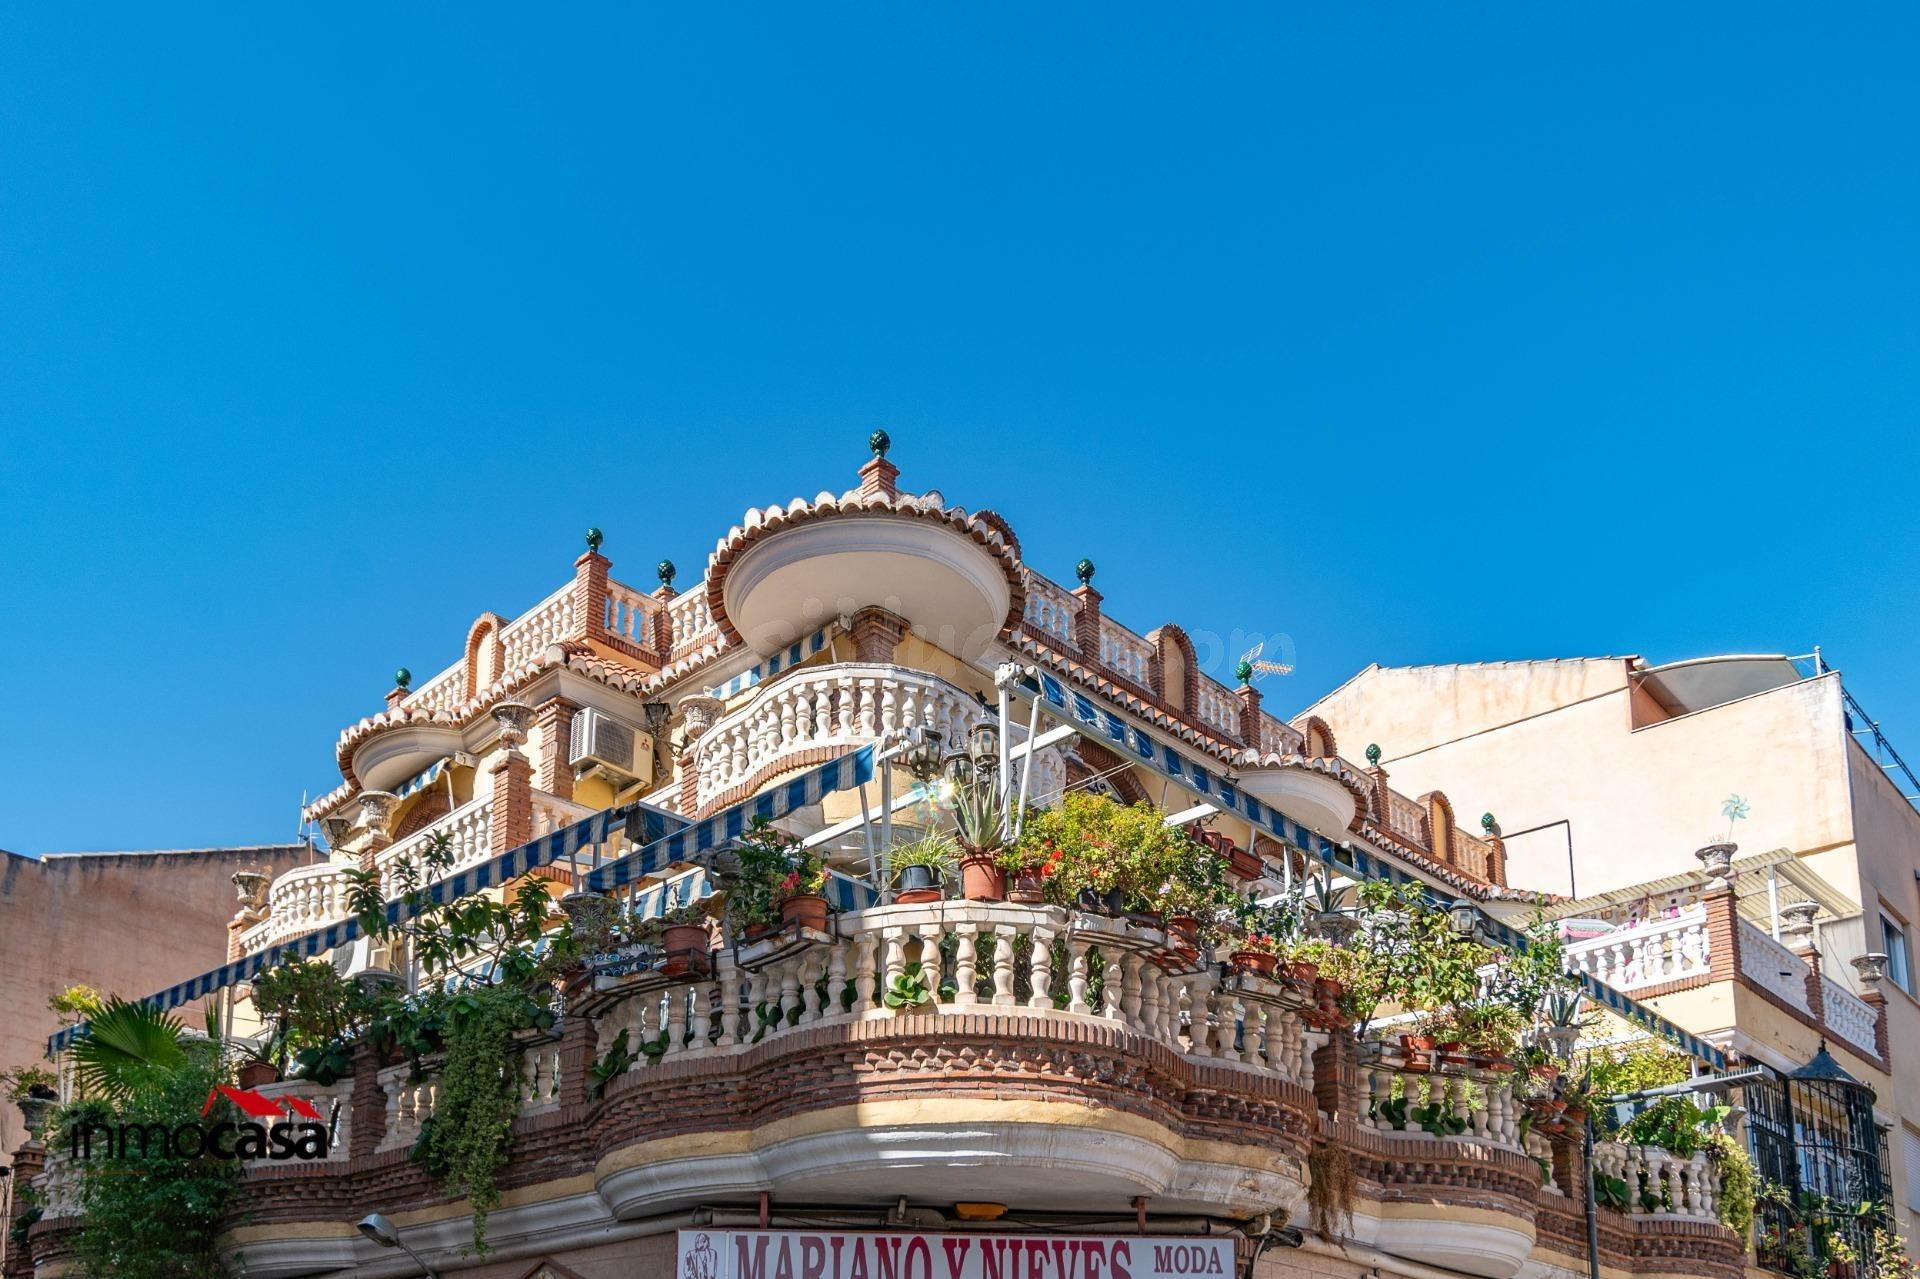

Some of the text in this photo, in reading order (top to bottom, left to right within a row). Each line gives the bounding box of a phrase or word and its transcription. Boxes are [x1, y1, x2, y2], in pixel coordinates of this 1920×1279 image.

[735, 1235, 1223, 1279] MARIANO Y NIEVES MODA
